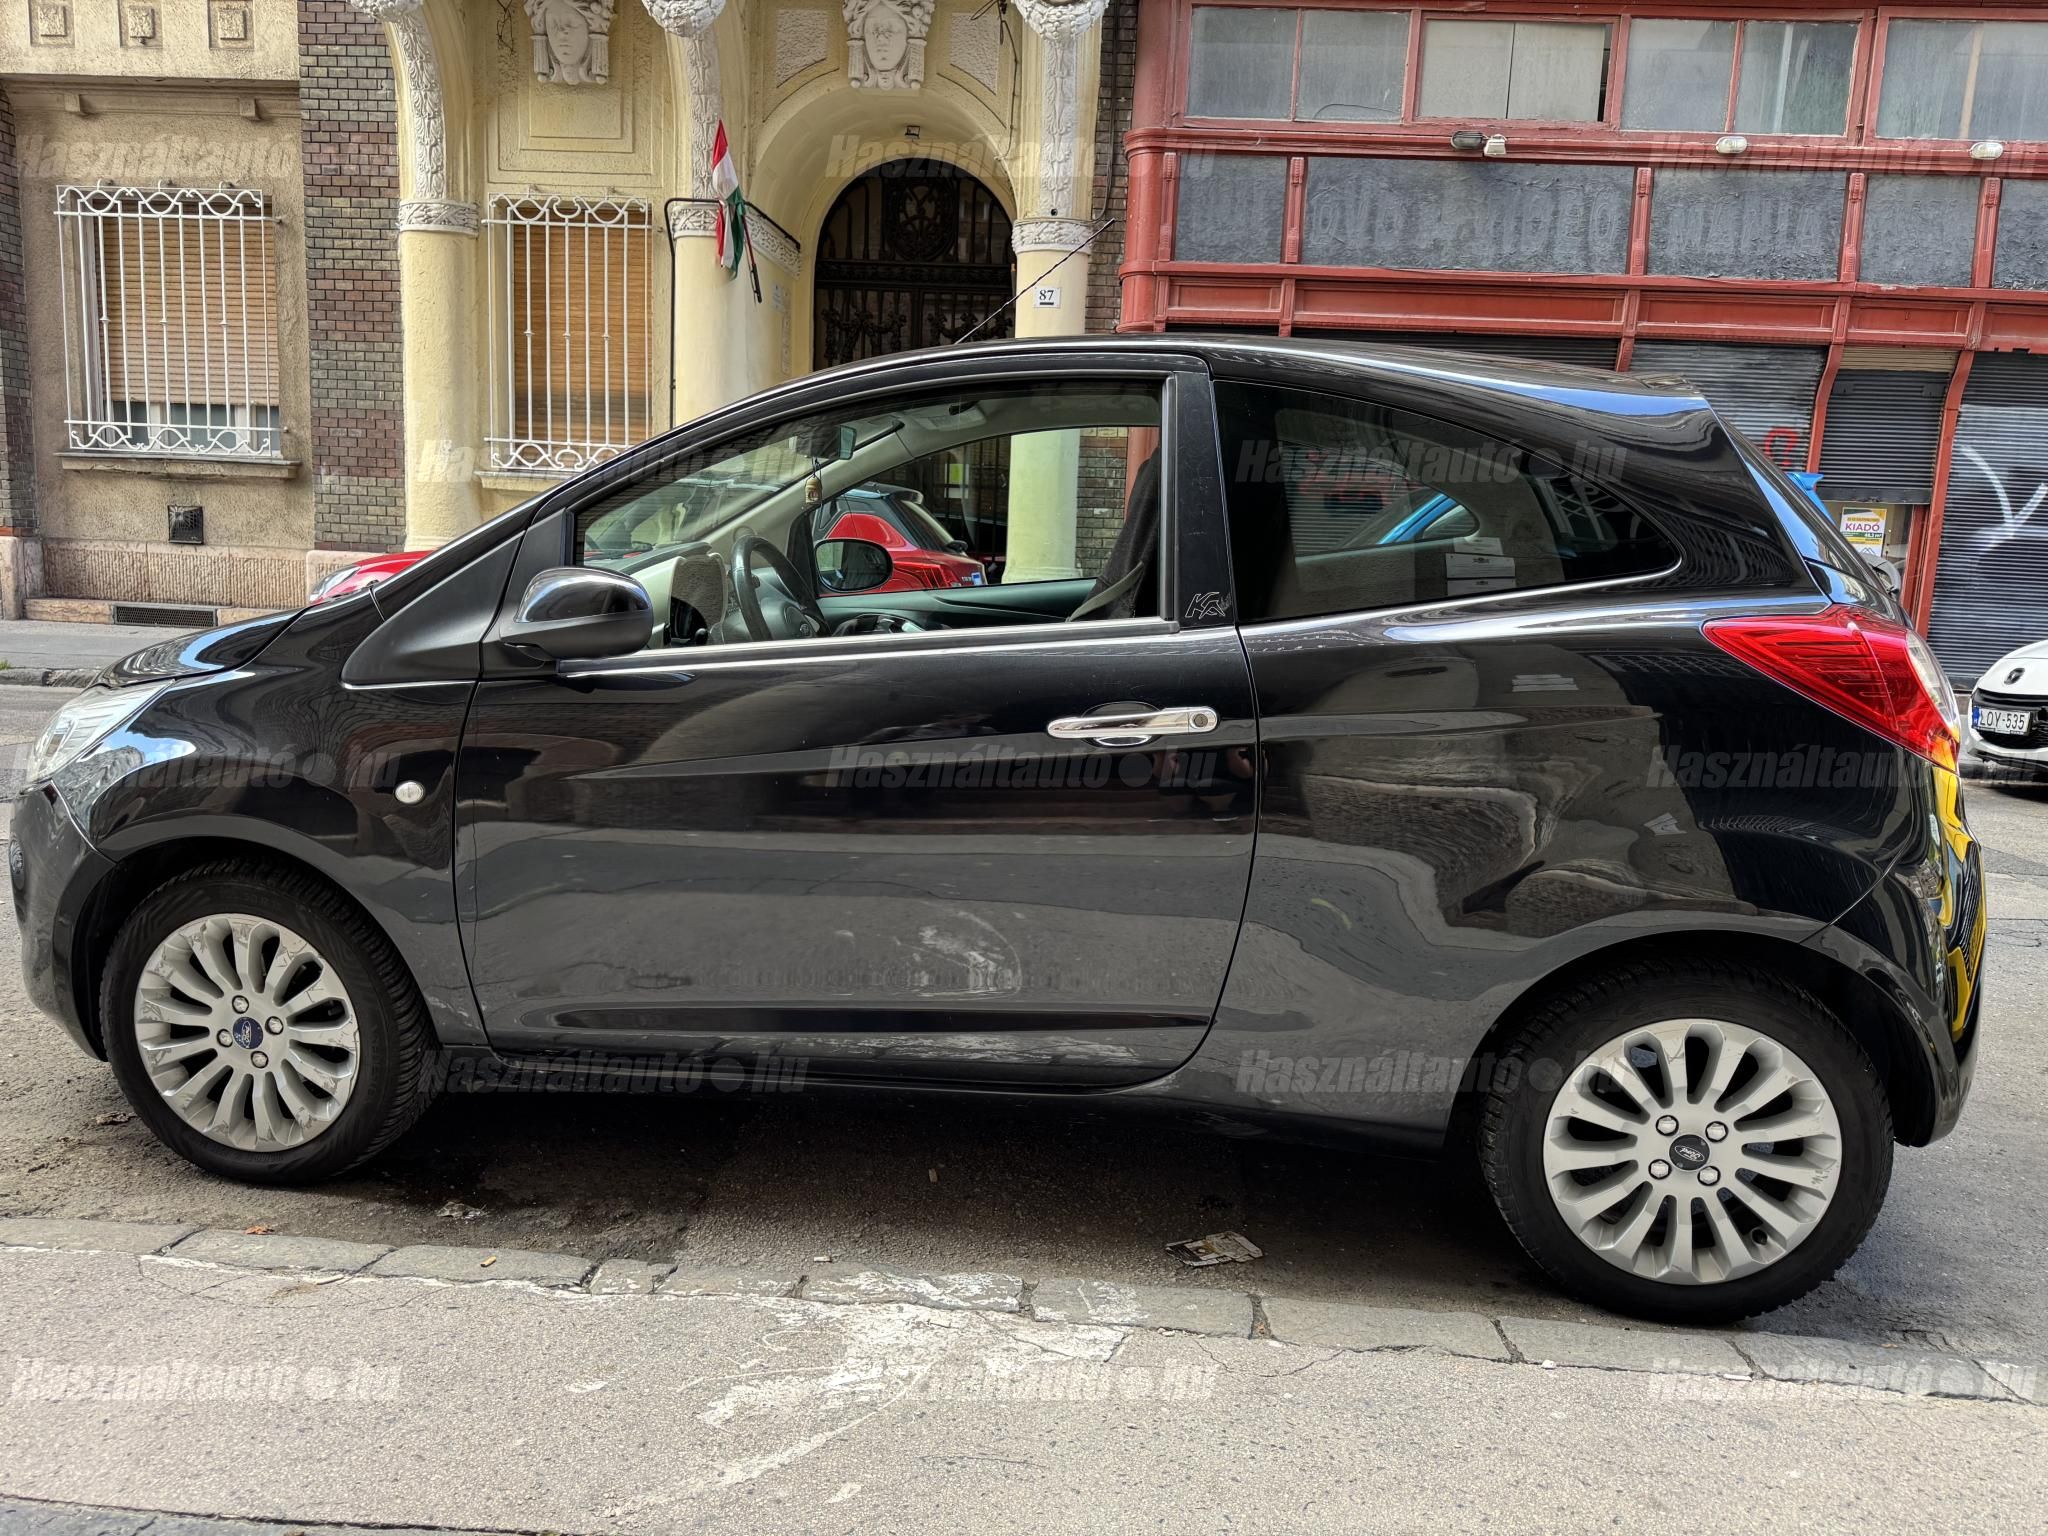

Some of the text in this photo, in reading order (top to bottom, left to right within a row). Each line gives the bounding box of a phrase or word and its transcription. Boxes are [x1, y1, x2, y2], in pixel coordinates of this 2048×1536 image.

[1039, 289, 1054, 301] 87
[1845, 522, 1880, 532] KIADÓ
[1980, 711, 2026, 730] LOY-535
